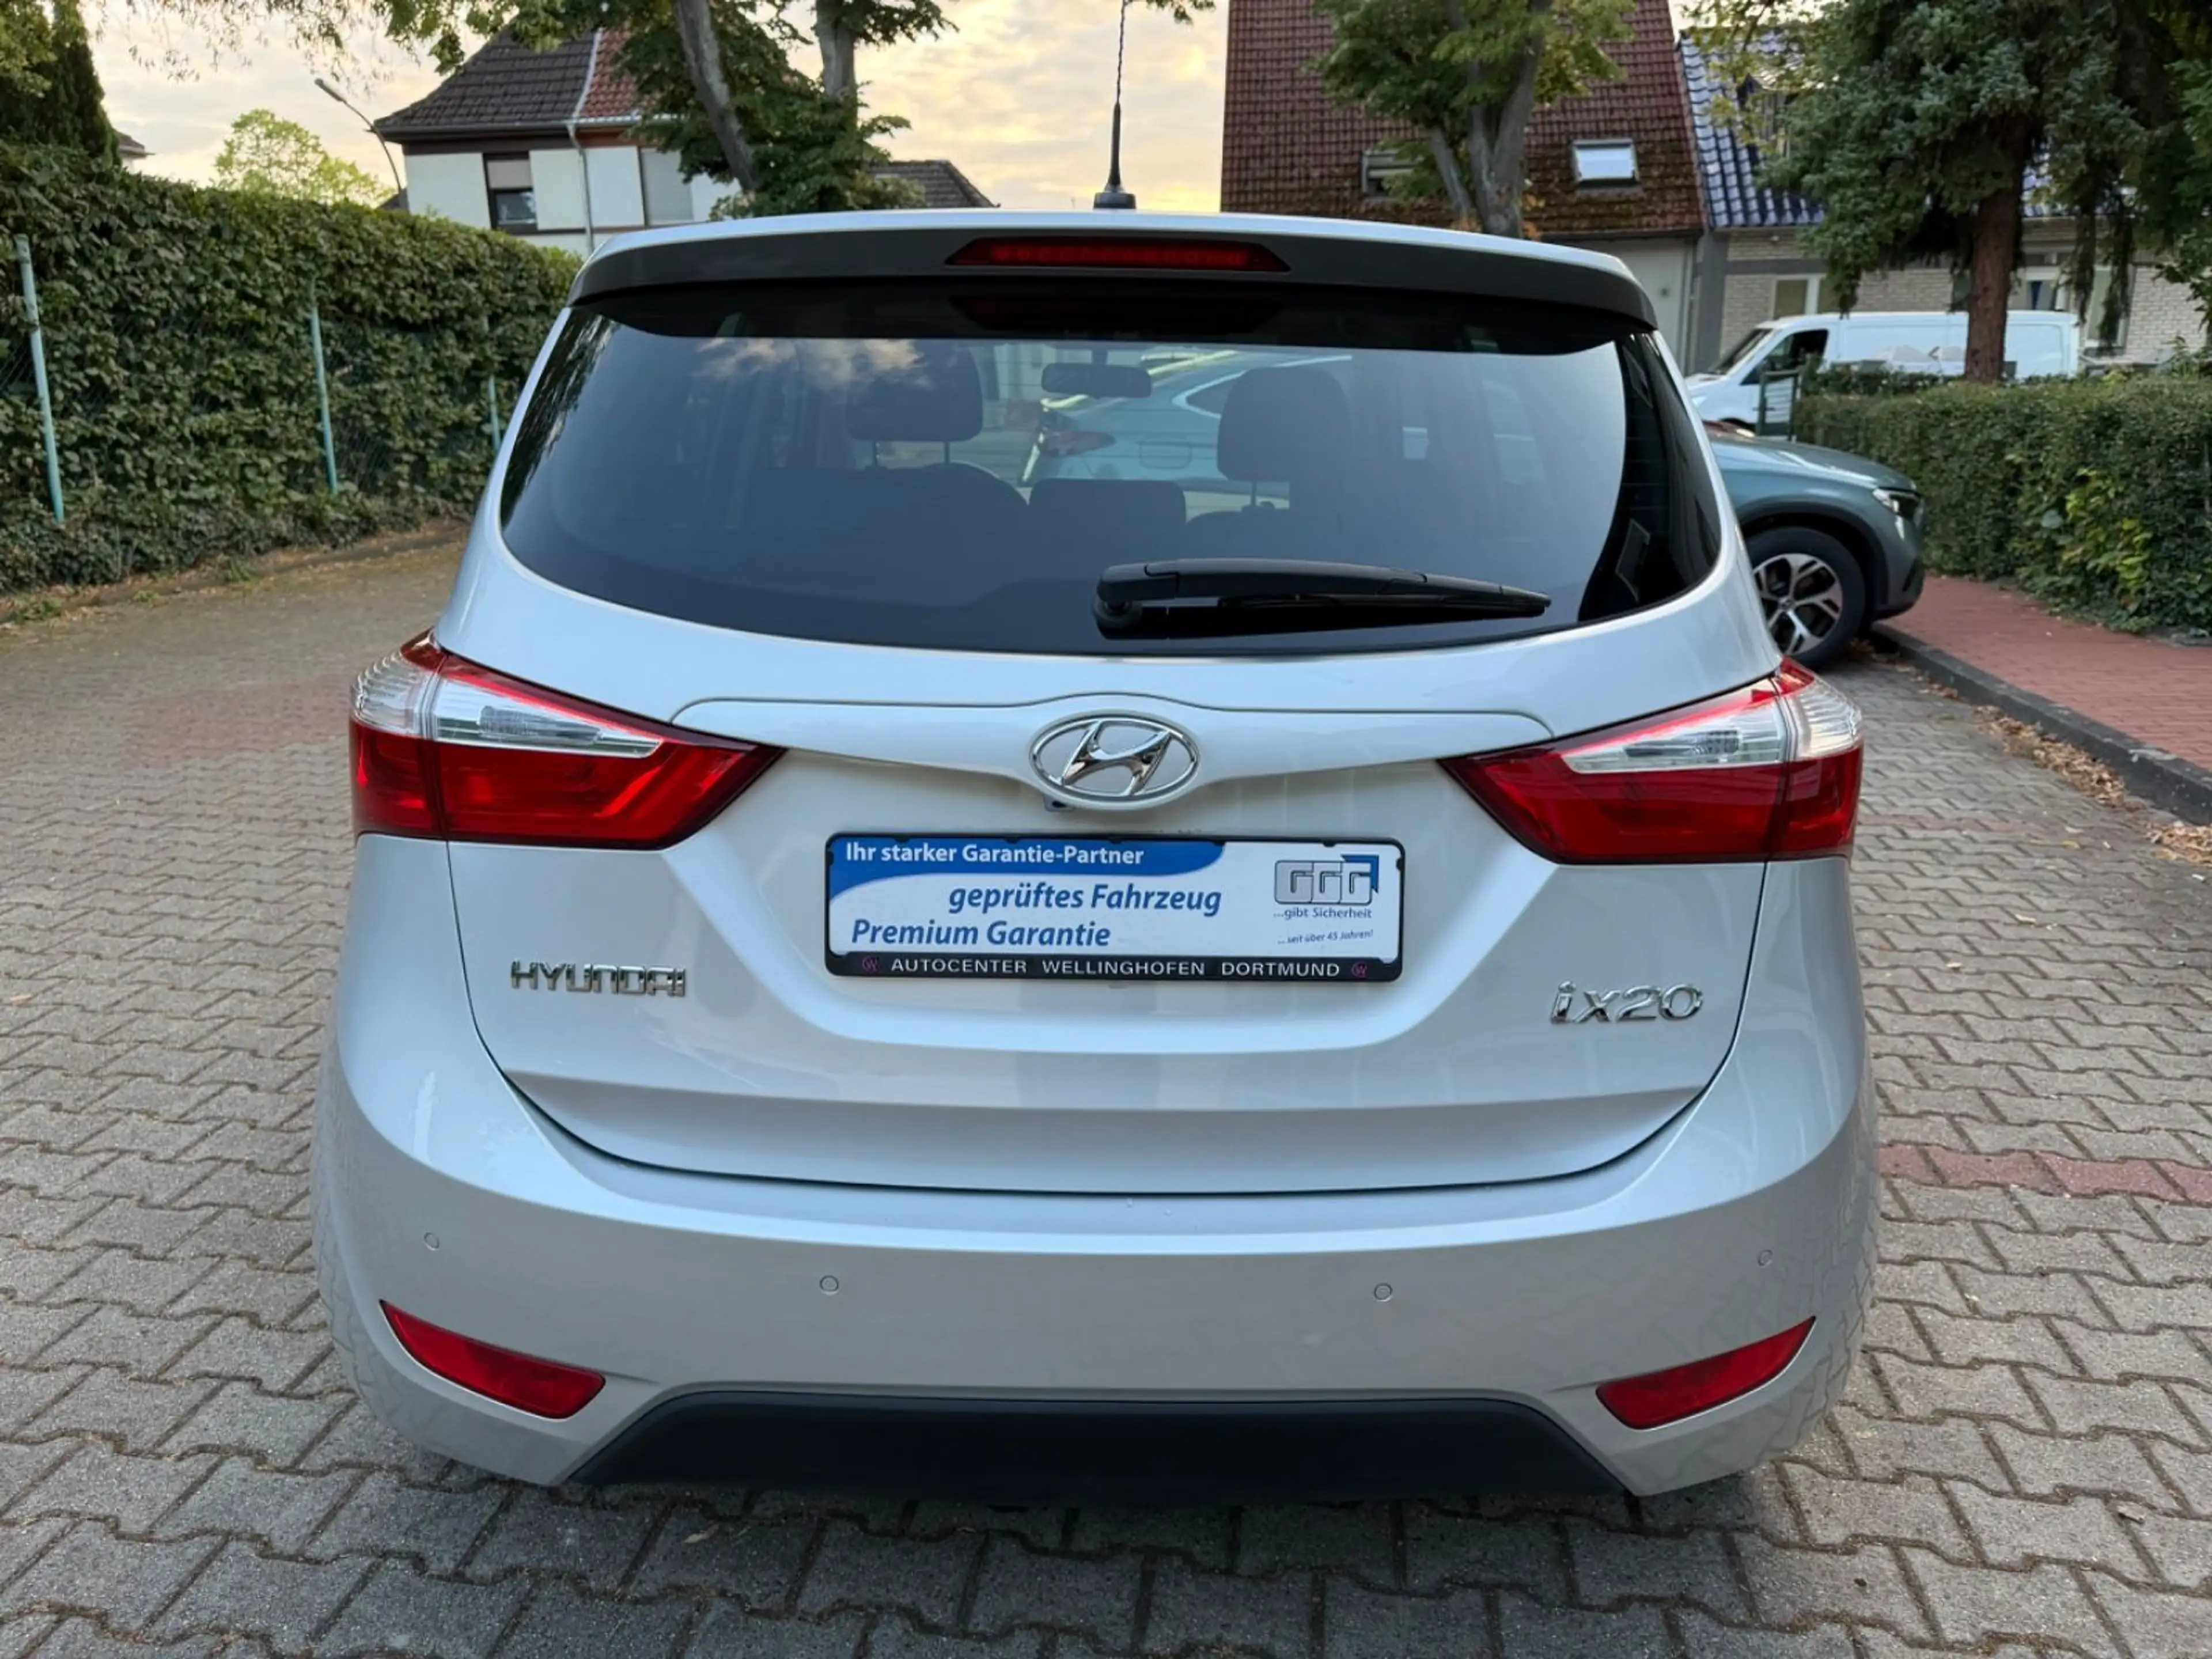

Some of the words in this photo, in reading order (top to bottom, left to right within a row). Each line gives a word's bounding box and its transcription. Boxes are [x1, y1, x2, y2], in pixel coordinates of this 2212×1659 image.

[845, 842, 876, 861] Ihr
[881, 842, 957, 862] starker
[962, 844, 1145, 865] Garantie-Partner
[949, 882, 1084, 914] geprüftes
[1090, 882, 1222, 918] Fahrzeug
[1313, 907, 1372, 919] Sicherheit
[851, 918, 979, 944] Premium
[986, 920, 1111, 946] Garantie
[1327, 931, 1338, 941] 45
[510, 957, 687, 998] HYUNDAI
[891, 958, 1028, 974] AUTOCENTER
[1042, 960, 1205, 975] WELLINGHOFEN
[1221, 961, 1340, 977] DORTMUND
[1550, 980, 1704, 1025] ix20
